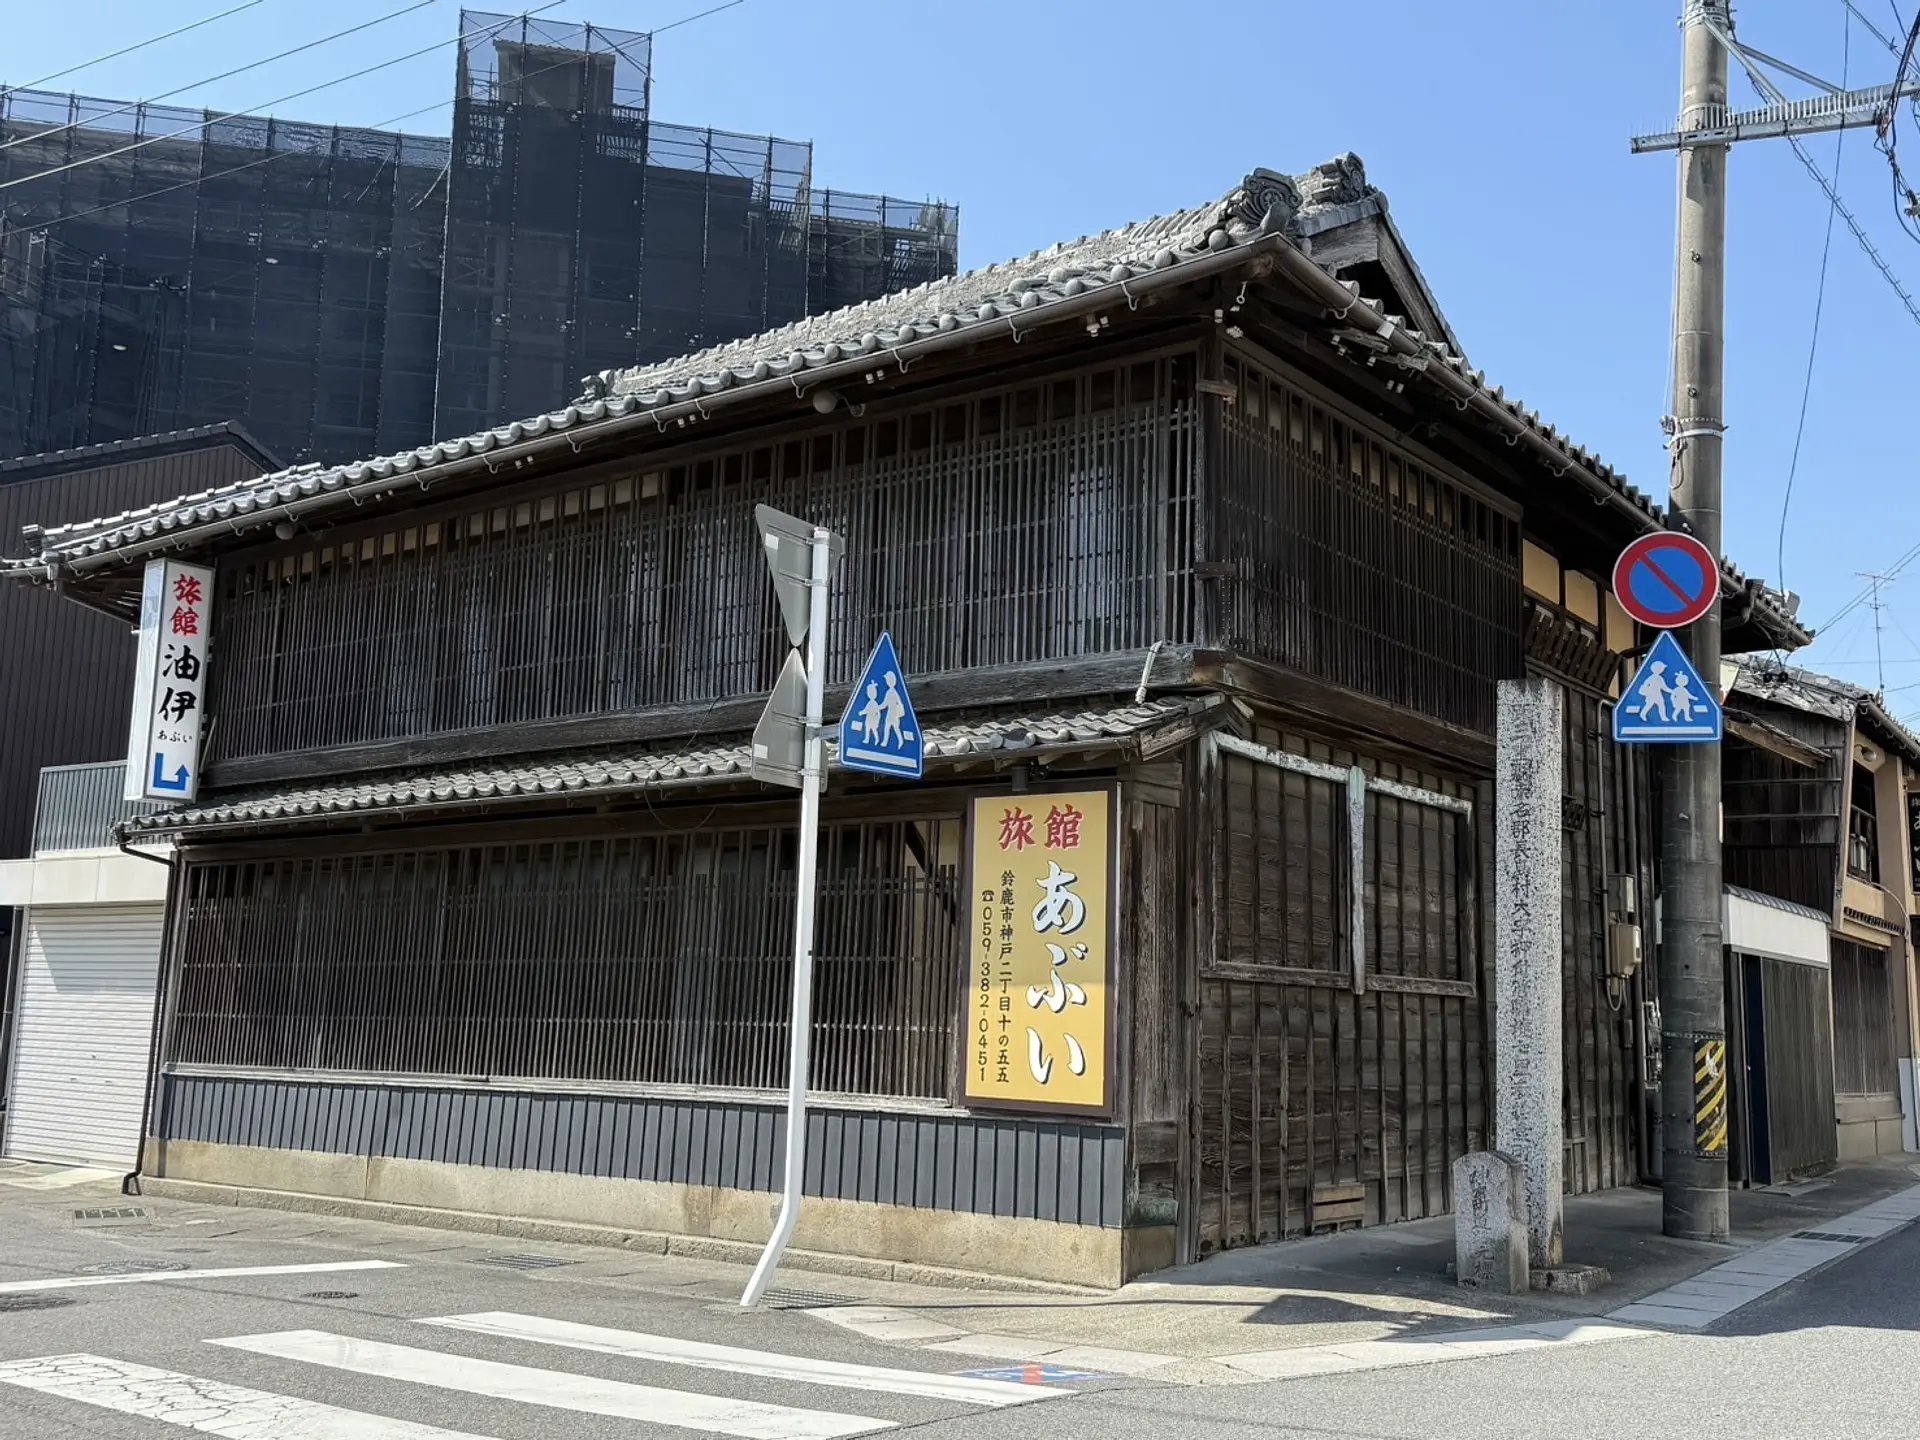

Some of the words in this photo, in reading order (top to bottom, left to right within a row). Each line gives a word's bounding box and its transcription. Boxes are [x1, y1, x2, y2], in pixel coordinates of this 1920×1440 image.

[170, 573, 203, 637] 旅館
[158, 644, 201, 724] 油伊
[158, 730, 193, 743] あぶい
[998, 803, 1084, 851] 旅館
[1025, 860, 1089, 1085] あぶい
